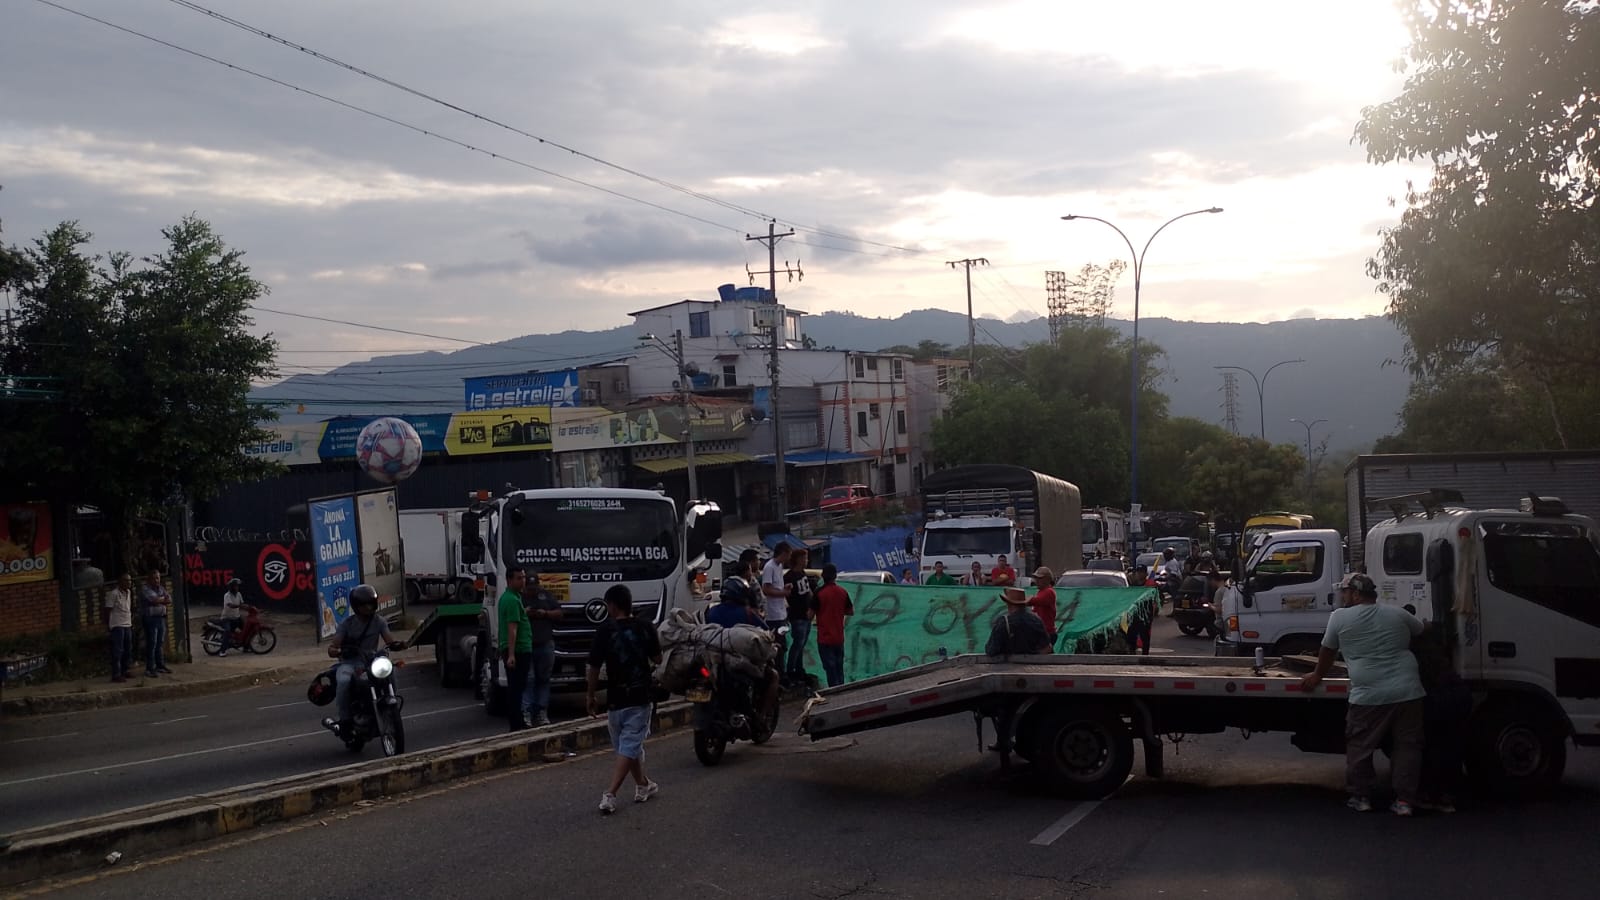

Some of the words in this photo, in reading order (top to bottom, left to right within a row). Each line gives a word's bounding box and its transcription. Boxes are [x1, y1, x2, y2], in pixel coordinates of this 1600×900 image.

[470, 391, 486, 408] la
[491, 385, 565, 405] estrella
[323, 507, 346, 524] ANDINA
[328, 524, 342, 541] LA
[320, 538, 353, 562] GRAMA
[561, 546, 642, 562] MIASISTENCIA
[645, 545, 669, 560] BGA
[569, 572, 623, 582] FOTON
